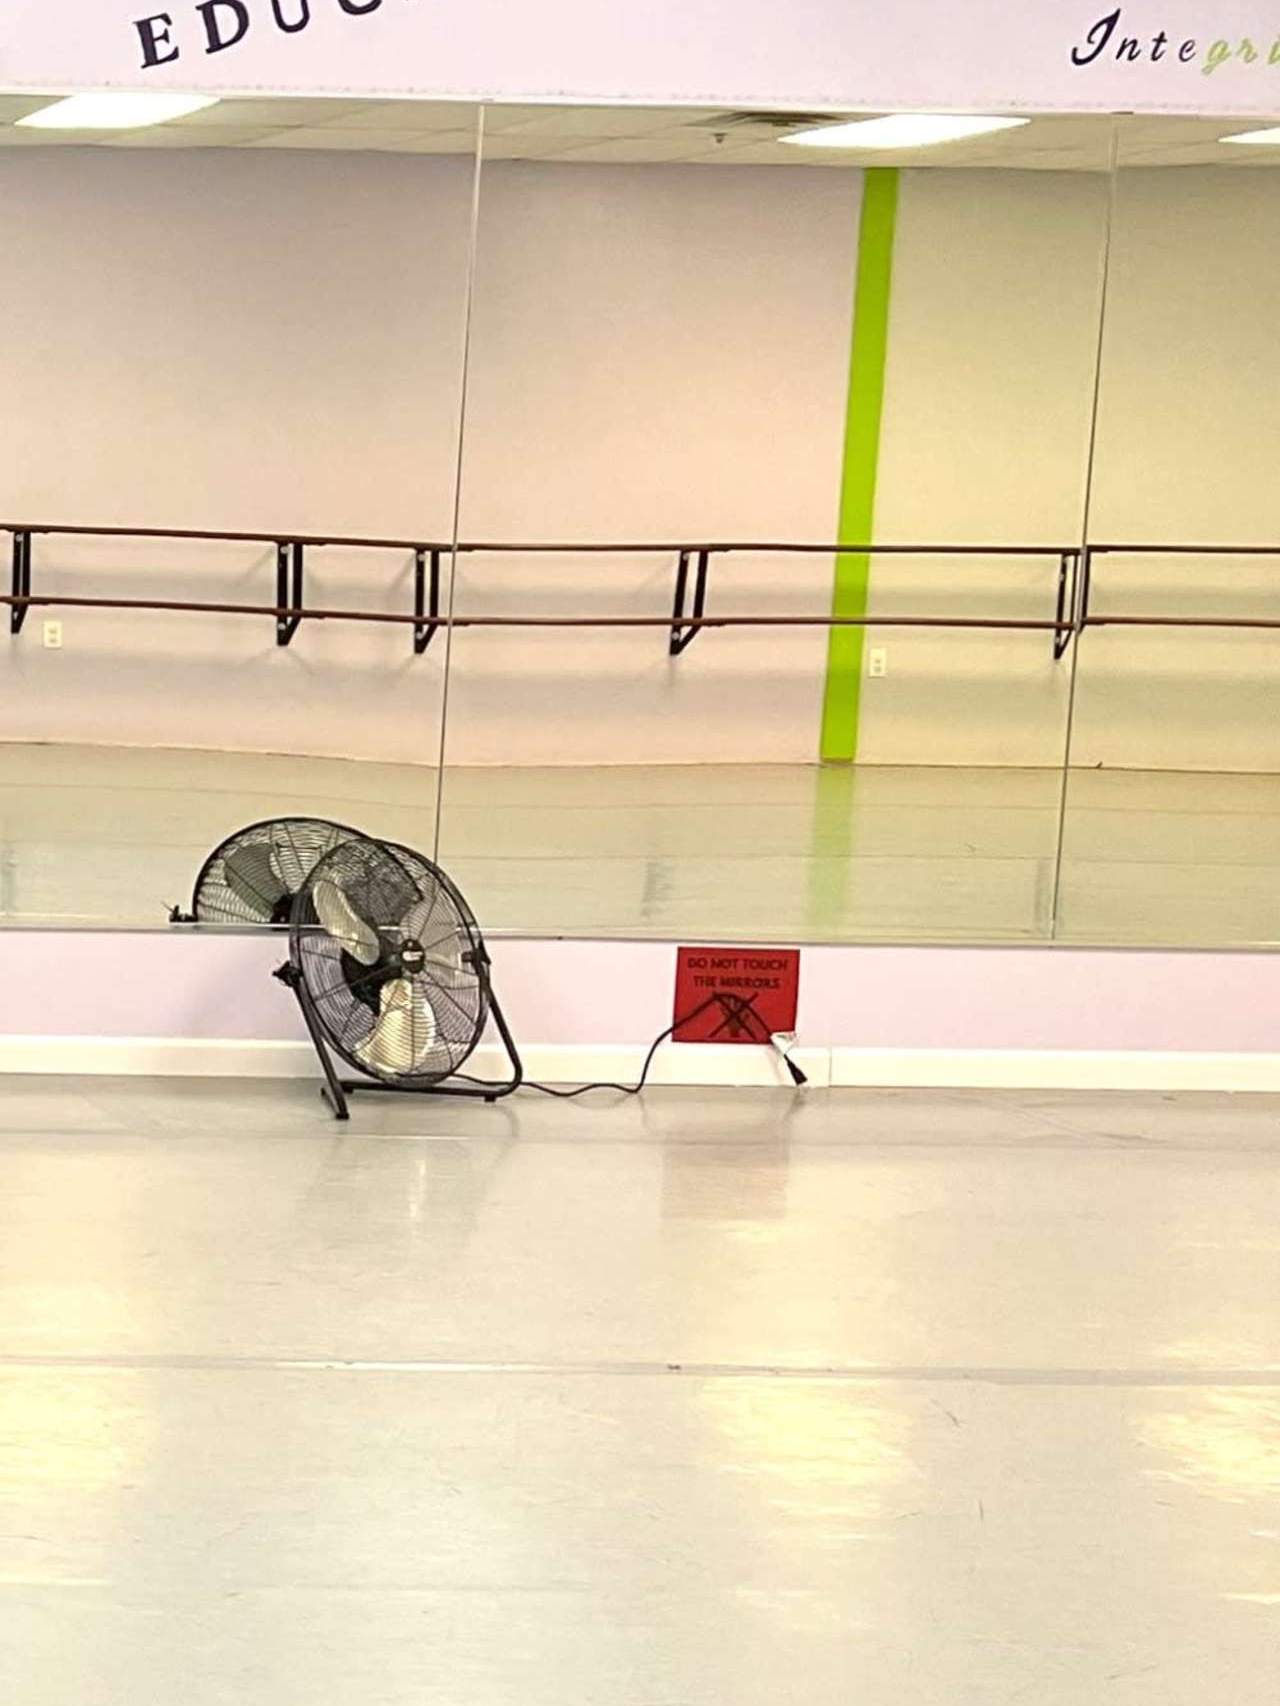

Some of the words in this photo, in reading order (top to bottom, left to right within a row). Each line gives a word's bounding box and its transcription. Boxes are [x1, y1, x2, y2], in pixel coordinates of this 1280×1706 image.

[687, 957, 708, 969] DO
[711, 959, 738, 970] NOT
[743, 959, 788, 970] TOUCH
[693, 976, 716, 987] THE
[719, 976, 780, 988] MIRRORS
